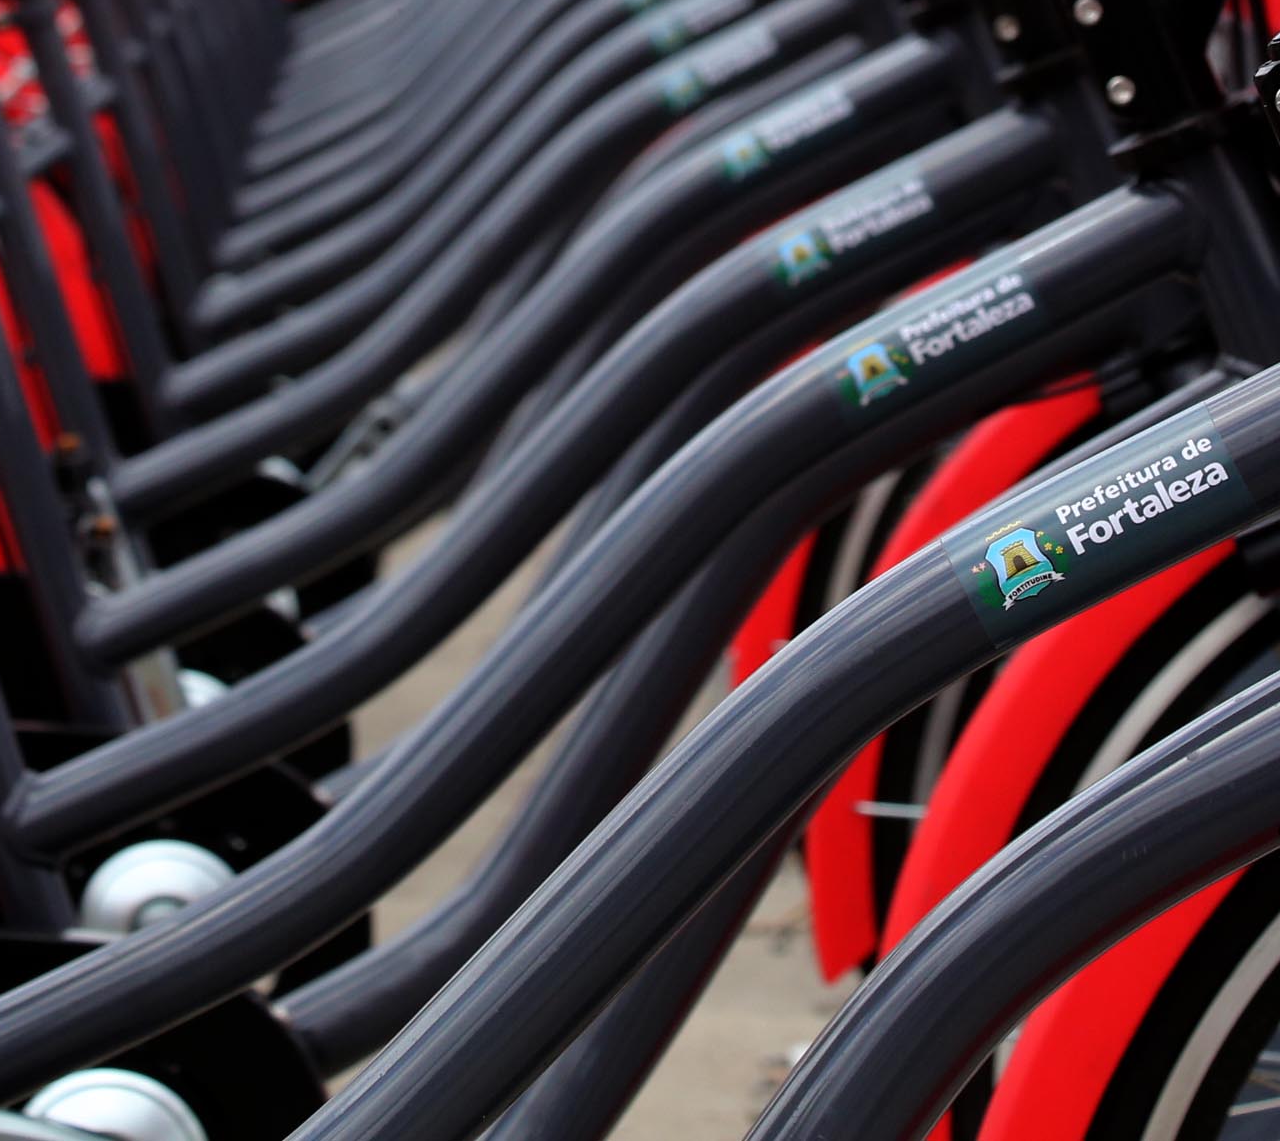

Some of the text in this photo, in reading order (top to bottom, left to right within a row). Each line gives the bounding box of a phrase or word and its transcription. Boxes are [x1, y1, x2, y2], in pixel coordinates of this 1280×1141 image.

[898, 273, 1023, 342] Prefeitura de
[908, 292, 1035, 366] Fortaleza
[1055, 437, 1213, 525] Prefeitura de
[1065, 461, 1230, 556] Fortaleza
[1008, 573, 1054, 601] FORTITUDINE
